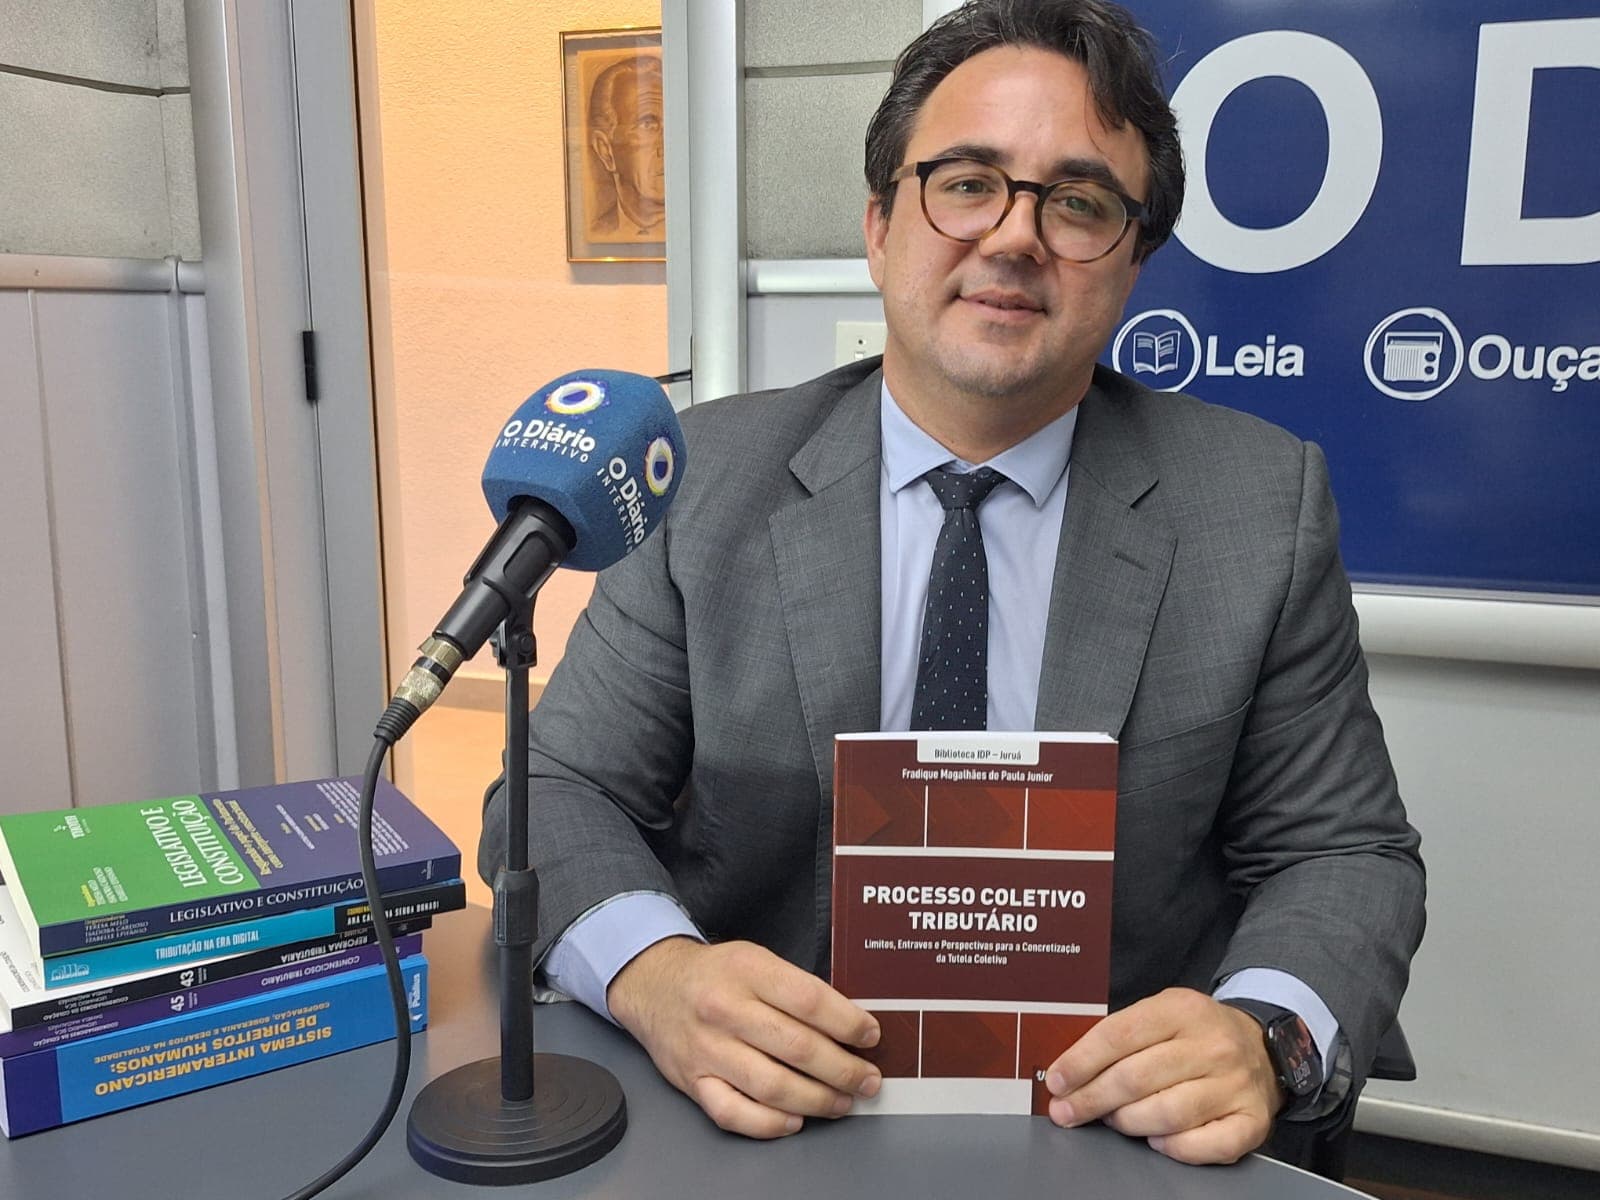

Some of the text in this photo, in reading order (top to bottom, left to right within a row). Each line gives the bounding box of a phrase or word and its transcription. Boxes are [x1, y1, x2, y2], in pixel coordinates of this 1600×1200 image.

[1170, 30, 1383, 273] O
[1206, 334, 1304, 377] Leia
[1468, 334, 1600, 392] Ouça
[503, 419, 595, 452] O Diário
[495, 439, 590, 463] INTERATIVO
[609, 457, 648, 544] O Diário
[934, 749, 975, 759] Biblioteca
[977, 750, 991, 759] IDP
[1000, 750, 1022, 760] Juruá
[902, 768, 939, 781] Fradique
[940, 768, 987, 782] Magalhães
[1001, 769, 1026, 782] Paula
[1026, 770, 1054, 783] Junior
[140, 806, 207, 888] LEGISLATIVO E
[172, 800, 244, 885] CONSTITUIÇÃO
[170, 878, 364, 923] LEGISLATIVO E CONSTITUIÇÃO
[863, 886, 1086, 908] PROCESSO COLETIVO
[908, 908, 1038, 932] TRIBUTÁRIO
[155, 929, 260, 960] TRIBUTAÇÃO NA ERA DIGITAL
[328, 935, 368, 951] REFORMA
[864, 938, 896, 952] Limites,
[897, 939, 933, 950] Entraves
[941, 939, 994, 952] Perspectivas
[995, 942, 1014, 952] para
[1022, 942, 1081, 955] Concretização
[304, 955, 360, 976] CONTENCIOSO
[936, 953, 1008, 965] da Tutela Coletiva
[180, 970, 194, 987] 43
[171, 995, 184, 1012] 45
[221, 1016, 271, 1033] SOBERANIA
[110, 1014, 317, 1074] DE DIREITOS HUMANOS:
[153, 1041, 166, 1050] NA
[168, 1030, 212, 1046] DESAFIOS
[94, 1045, 151, 1064] ATUALIDADE
[95, 1026, 332, 1096] SISTEMA INTERAMERICANO
